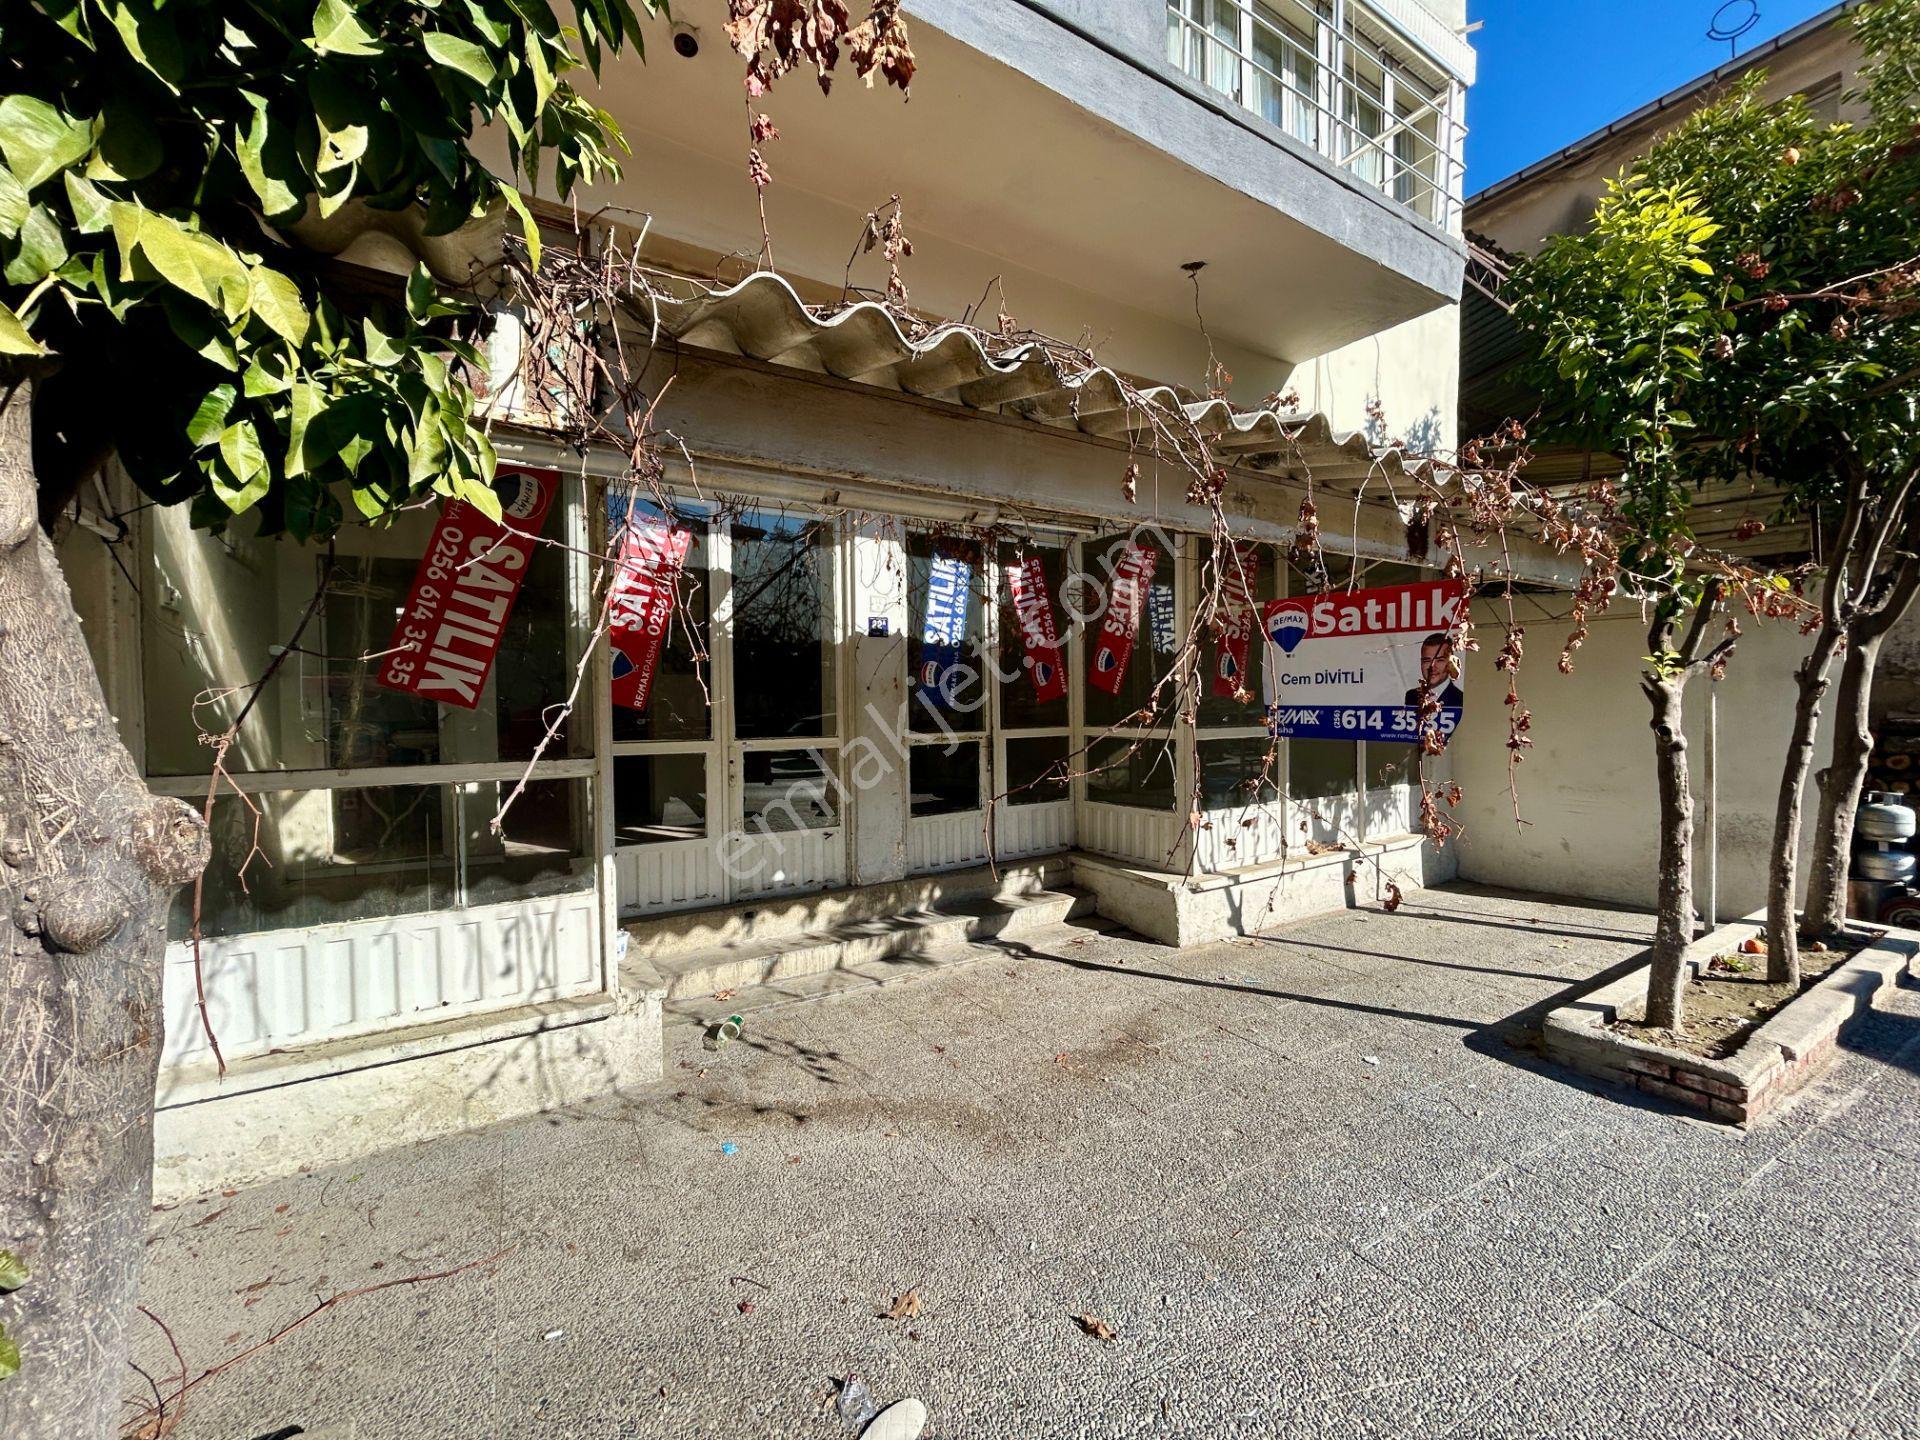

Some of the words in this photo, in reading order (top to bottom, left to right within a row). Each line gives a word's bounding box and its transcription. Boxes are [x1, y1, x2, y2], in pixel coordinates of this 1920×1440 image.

[514, 480, 533, 514] RE/MAX
[430, 526, 464, 581] 0256
[1031, 559, 1041, 573] 35
[1035, 575, 1045, 589] 35
[411, 585, 441, 621] 614
[925, 552, 958, 648] SATILIK
[954, 594, 966, 615] 614
[1316, 588, 1462, 633] Satılık
[416, 535, 526, 704] SATILIK
[647, 599, 668, 636] 0256
[951, 617, 963, 648] 0256
[1273, 616, 1304, 626] RE/MAX
[399, 625, 428, 653] 35
[387, 656, 415, 686] 35
[1281, 673, 1311, 685] Cem
[1315, 668, 1364, 685] DİVİTLİ
[1342, 709, 1384, 731] 614
[1391, 709, 1417, 731] 35
[1424, 712, 1455, 734] 35
